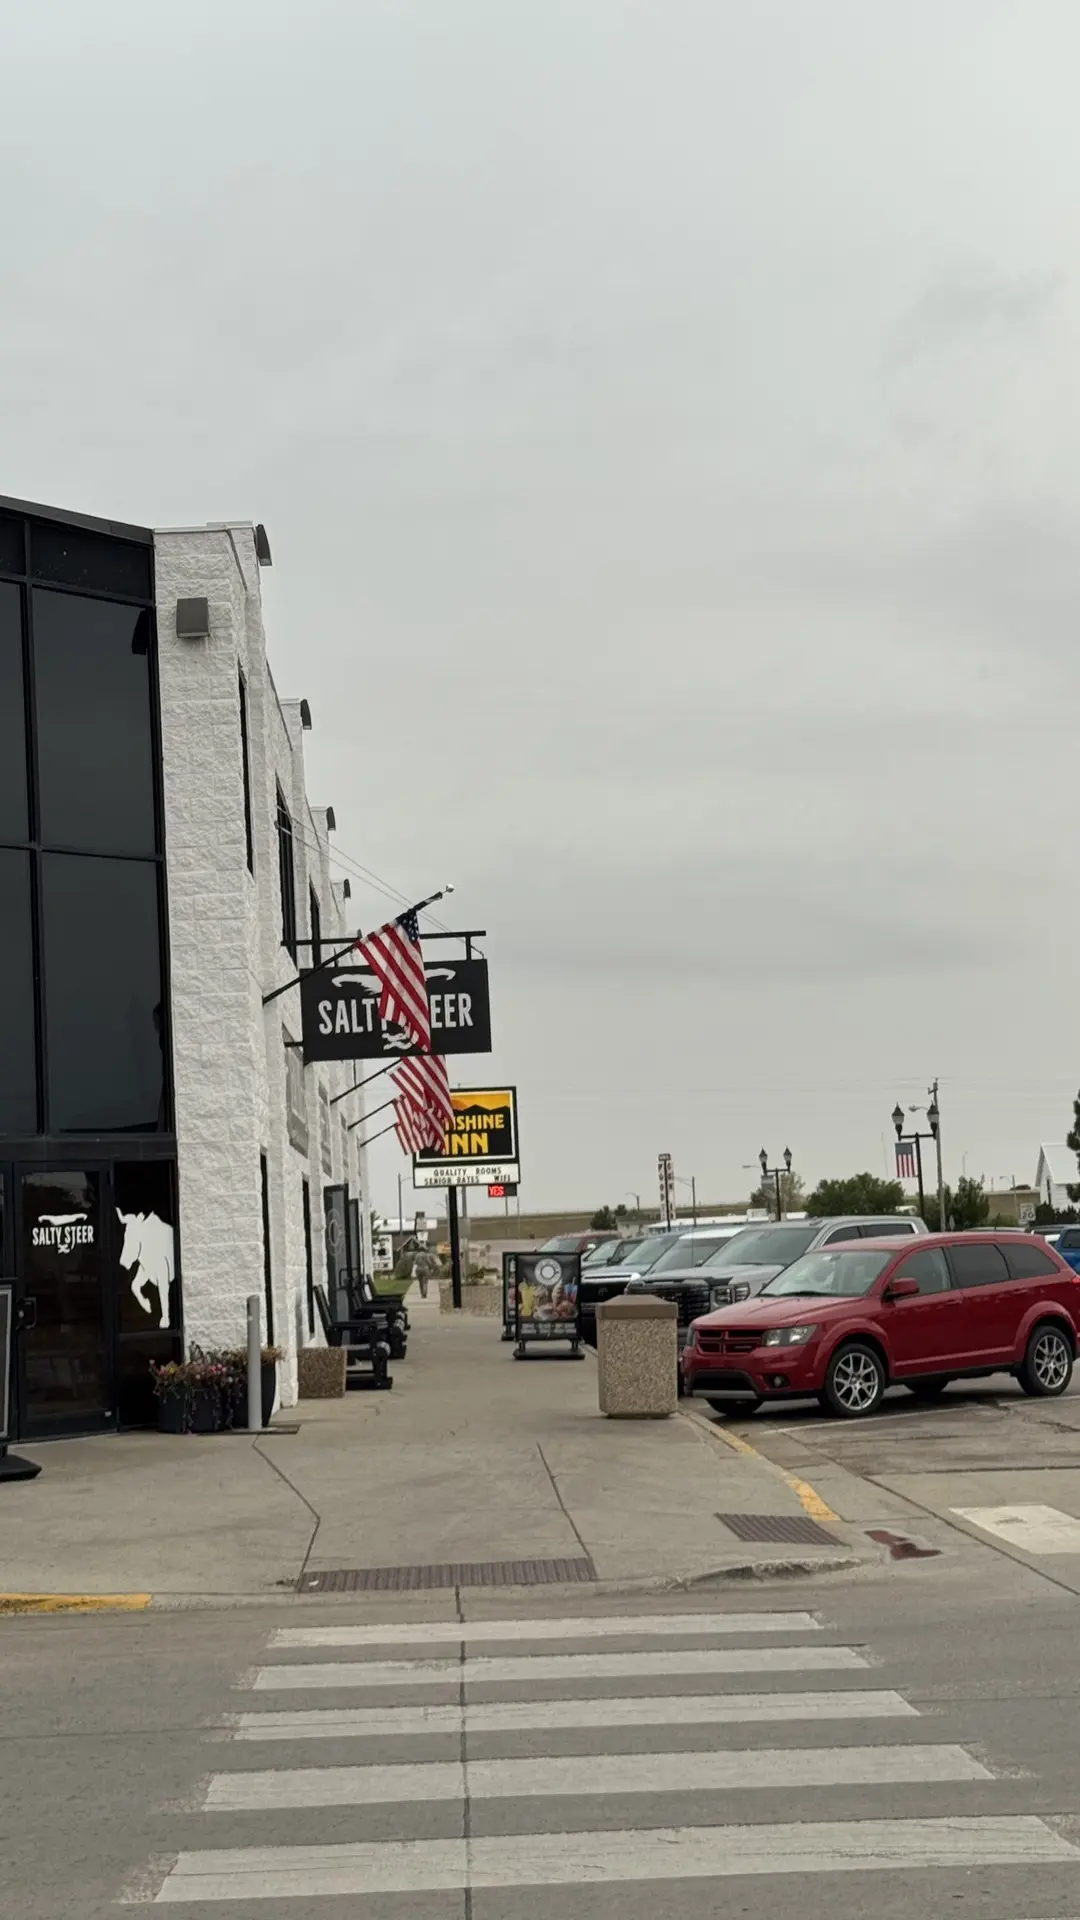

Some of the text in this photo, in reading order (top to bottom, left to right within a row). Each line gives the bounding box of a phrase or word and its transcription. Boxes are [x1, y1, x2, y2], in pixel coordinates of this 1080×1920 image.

[420, 993, 474, 1030] EER
[445, 1114, 505, 1131] SHINE
[433, 1167, 502, 1176] QUALITY ROOMS
[424, 1178, 452, 1186] SENIOR
[488, 1186, 504, 1196] YES
[32, 1225, 94, 1250] SALTY STEER
